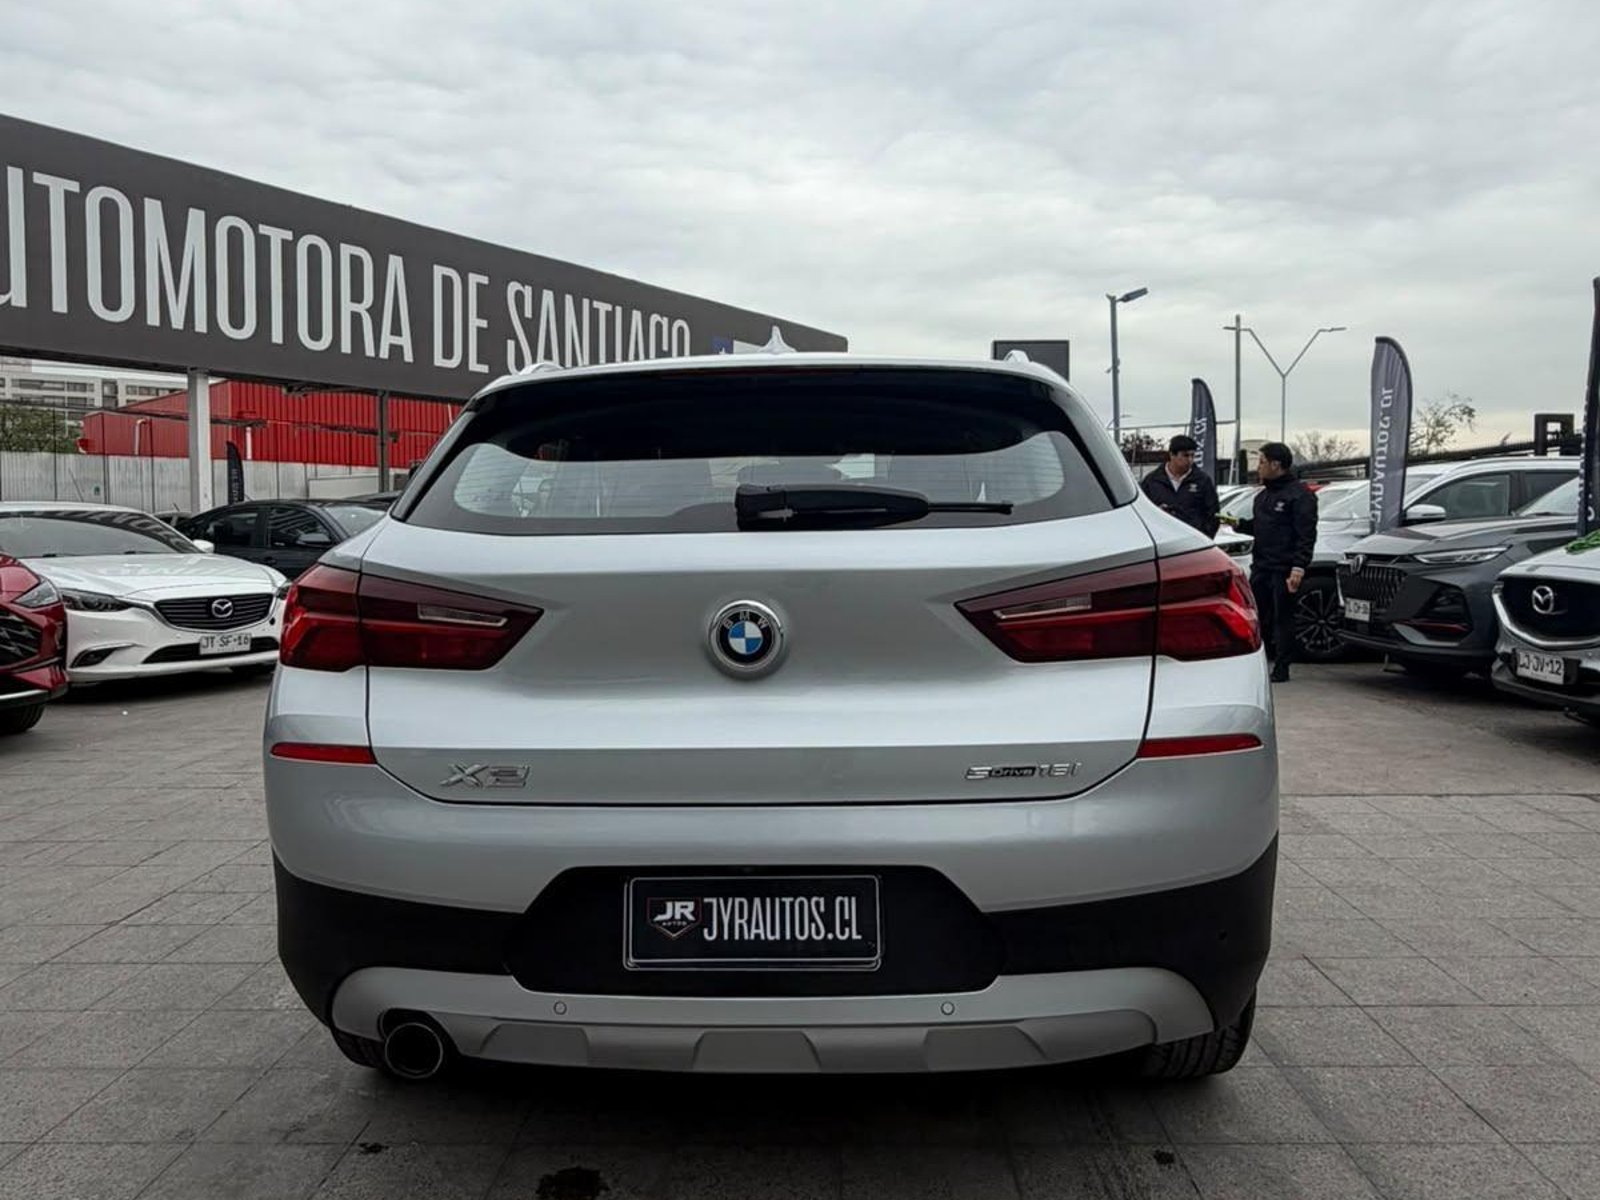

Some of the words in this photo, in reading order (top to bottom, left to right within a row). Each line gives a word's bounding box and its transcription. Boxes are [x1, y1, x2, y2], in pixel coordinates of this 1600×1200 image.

[433, 264, 489, 374] DE
[722, 608, 770, 630] BMW
[439, 763, 531, 789] X2
[653, 901, 696, 921] JR
[703, 896, 862, 941] JYRAUTOS.CL
